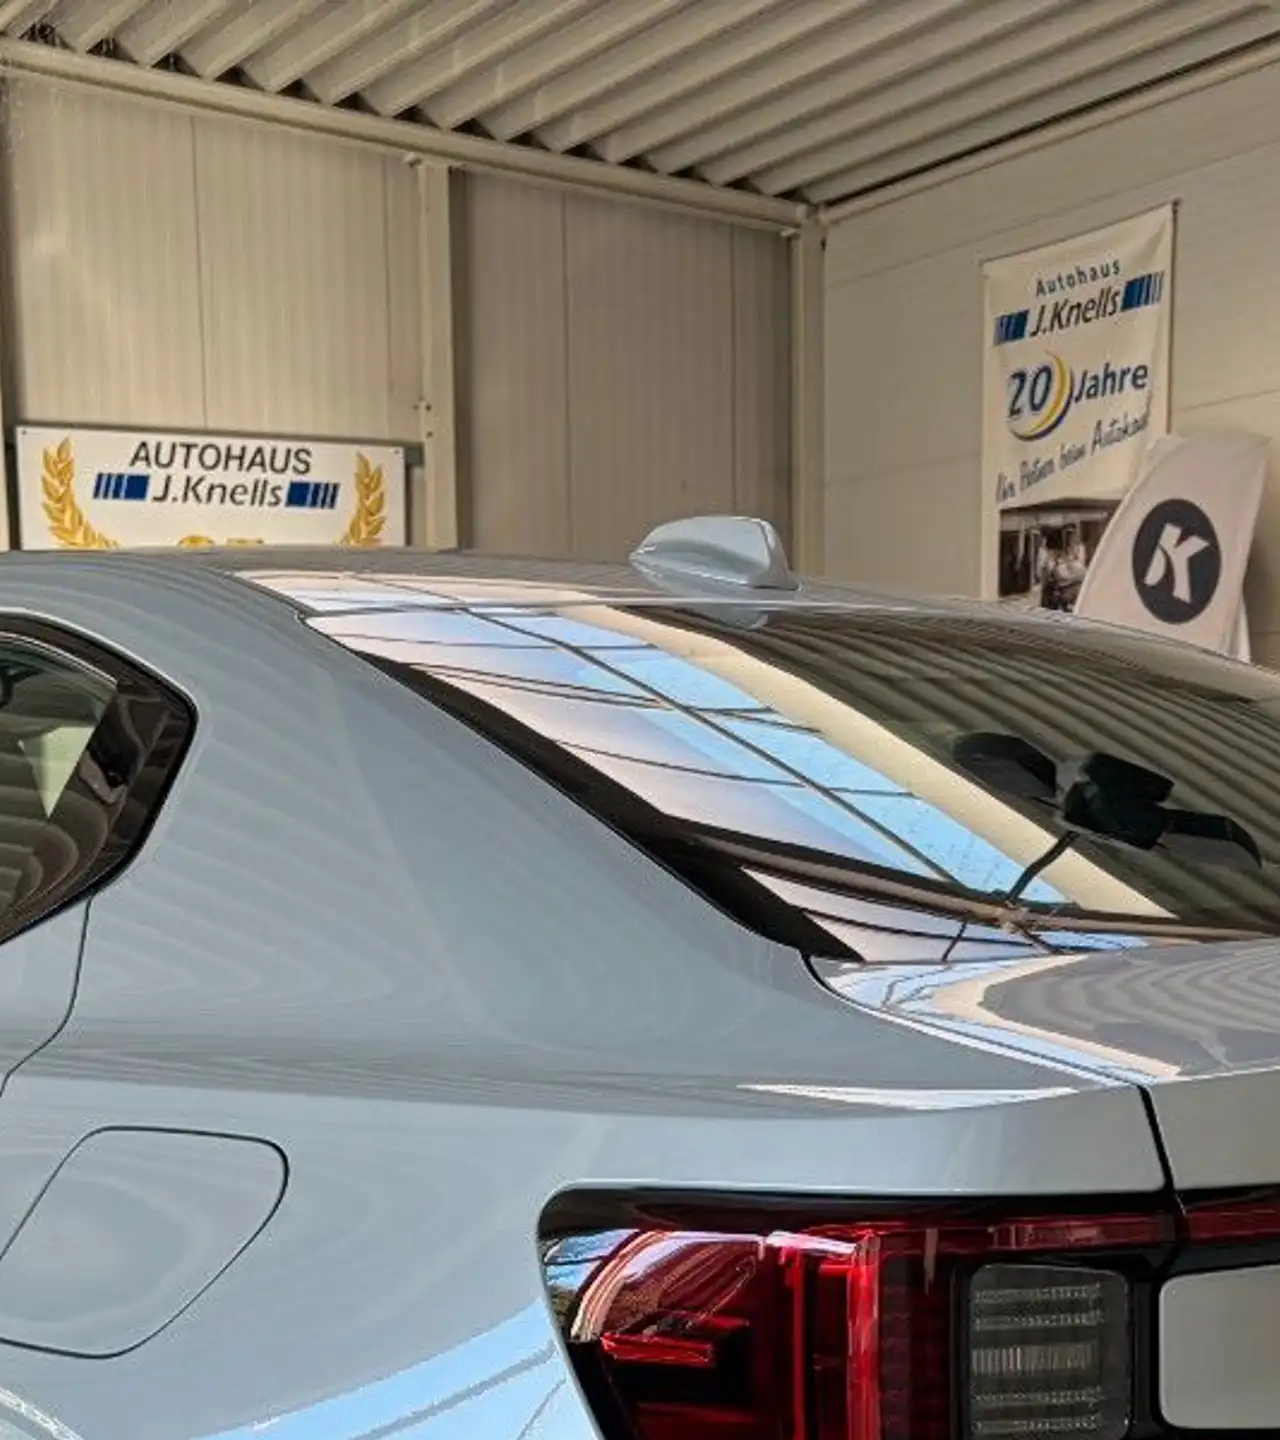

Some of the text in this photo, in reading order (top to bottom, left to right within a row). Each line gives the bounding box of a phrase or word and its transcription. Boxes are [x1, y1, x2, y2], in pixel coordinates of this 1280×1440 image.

[1036, 259, 1120, 299] Autohaus
[1030, 286, 1120, 337] J.Knells
[1008, 361, 1148, 418] 20 Jahre
[129, 441, 312, 475] AUTOHAUS
[153, 475, 284, 508] J.Knells
